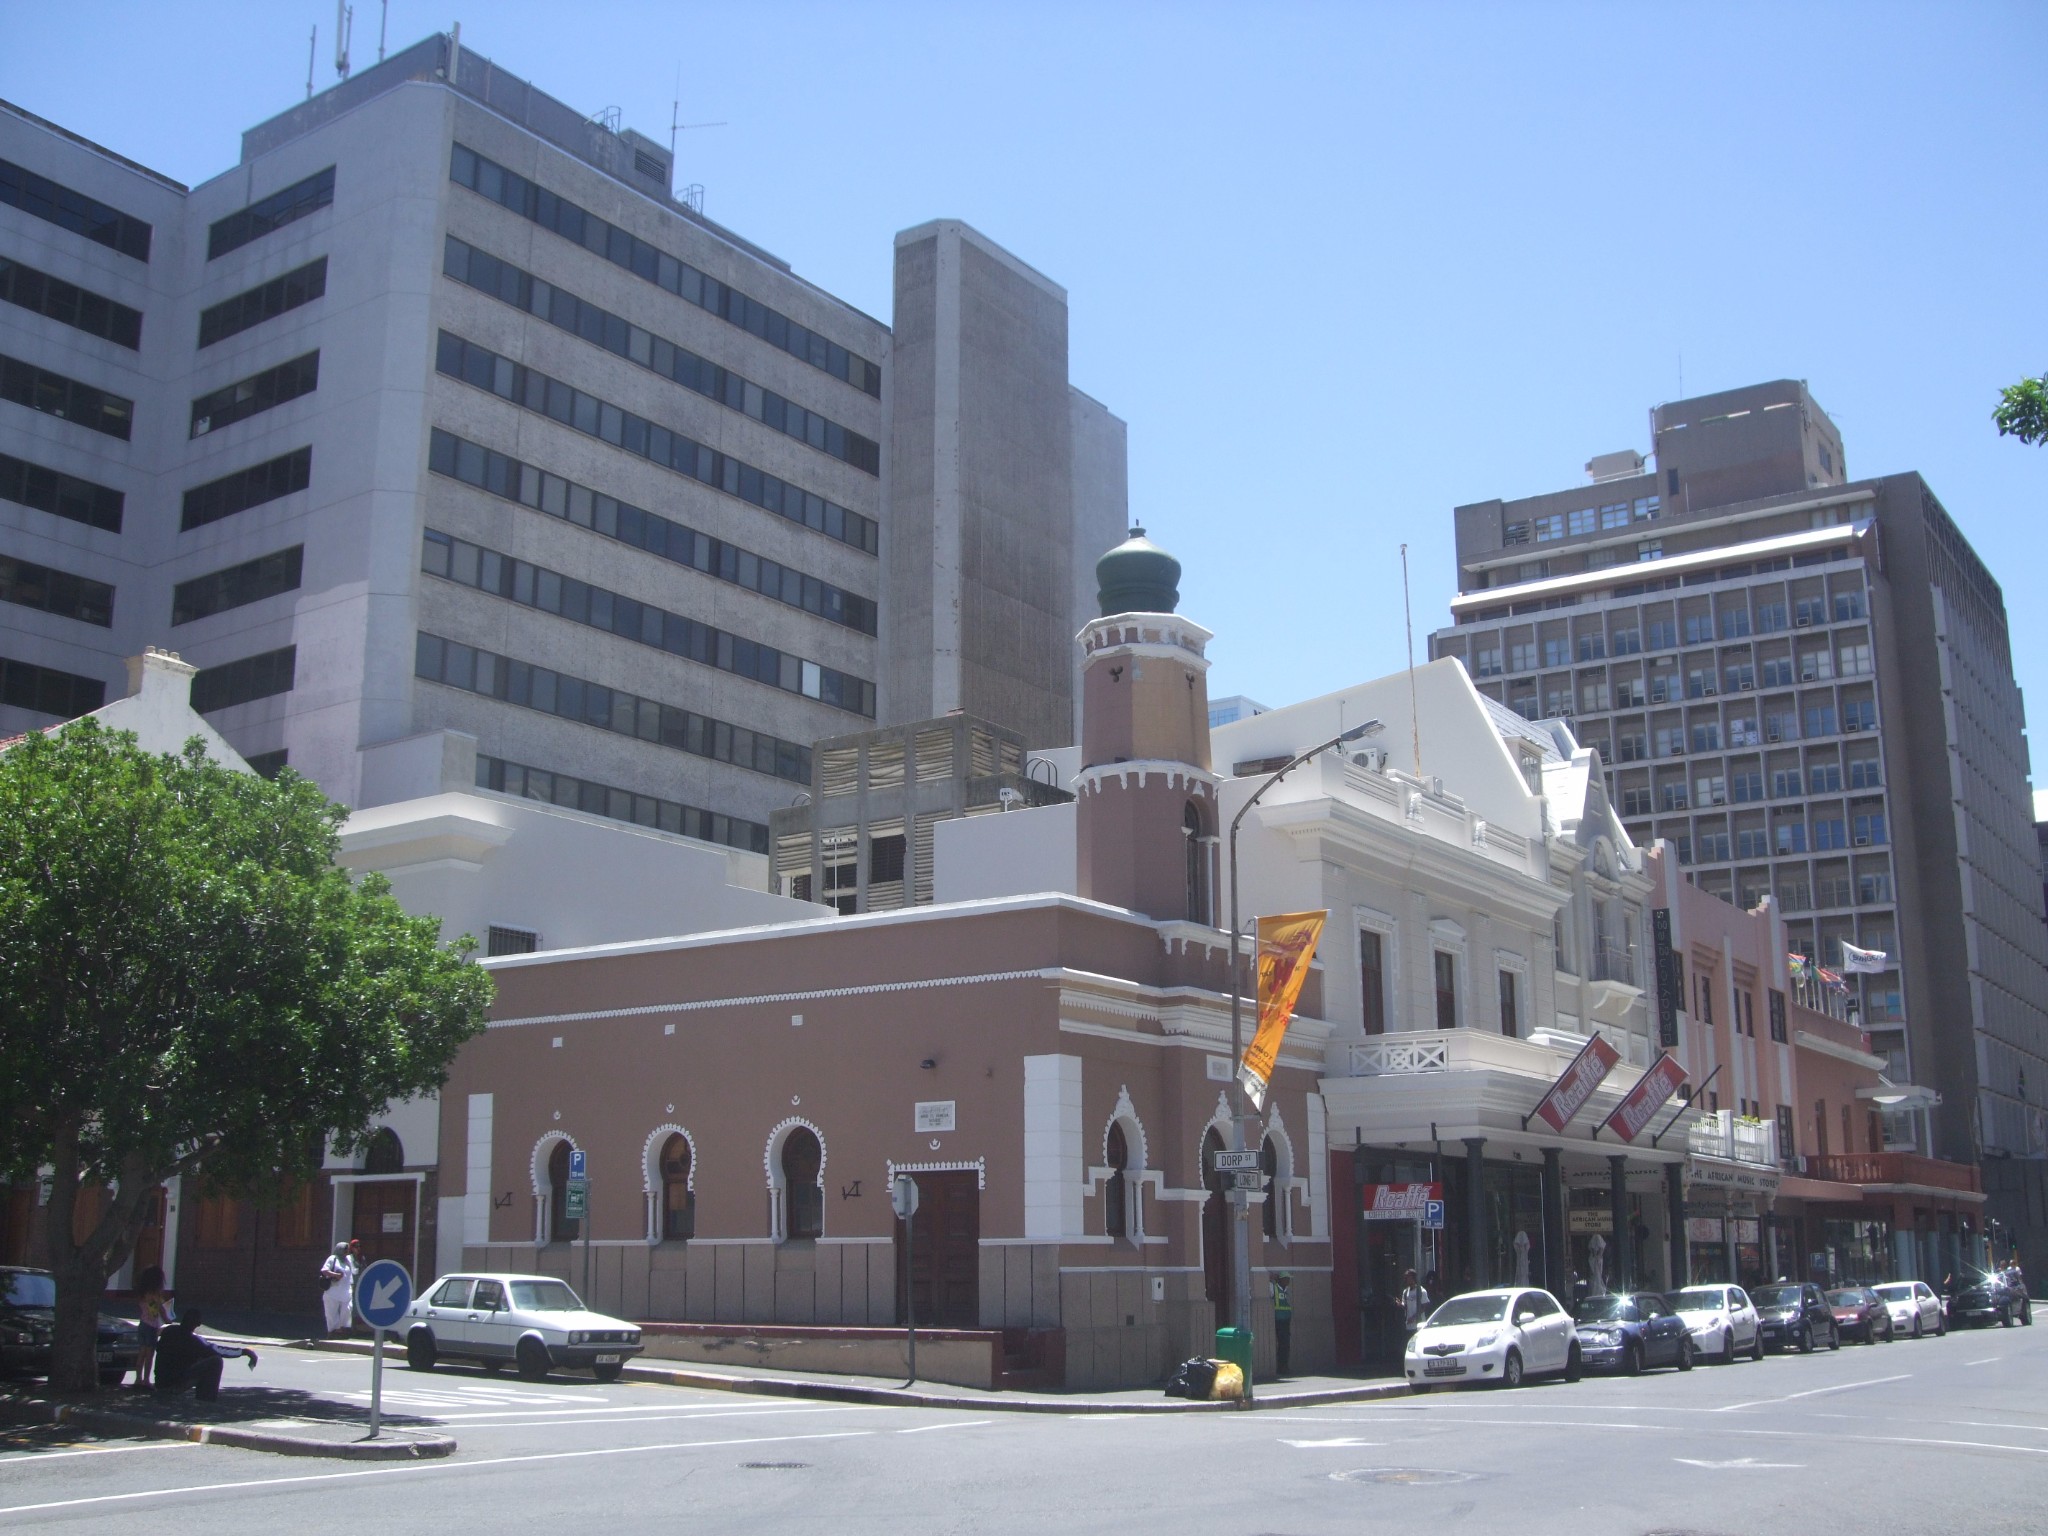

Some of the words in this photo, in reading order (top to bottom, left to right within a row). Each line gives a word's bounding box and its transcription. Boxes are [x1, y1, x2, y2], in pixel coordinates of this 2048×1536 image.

[573, 1153, 582, 1166] P
[1221, 1154, 1243, 1166] DORP
[1239, 1173, 1251, 1186] LONG
[1707, 1171, 1733, 1182] AFRICAN
[1737, 1175, 1755, 1186] MUSIC
[1760, 1178, 1777, 1189] STORE
[1428, 1202, 1440, 1218] P
